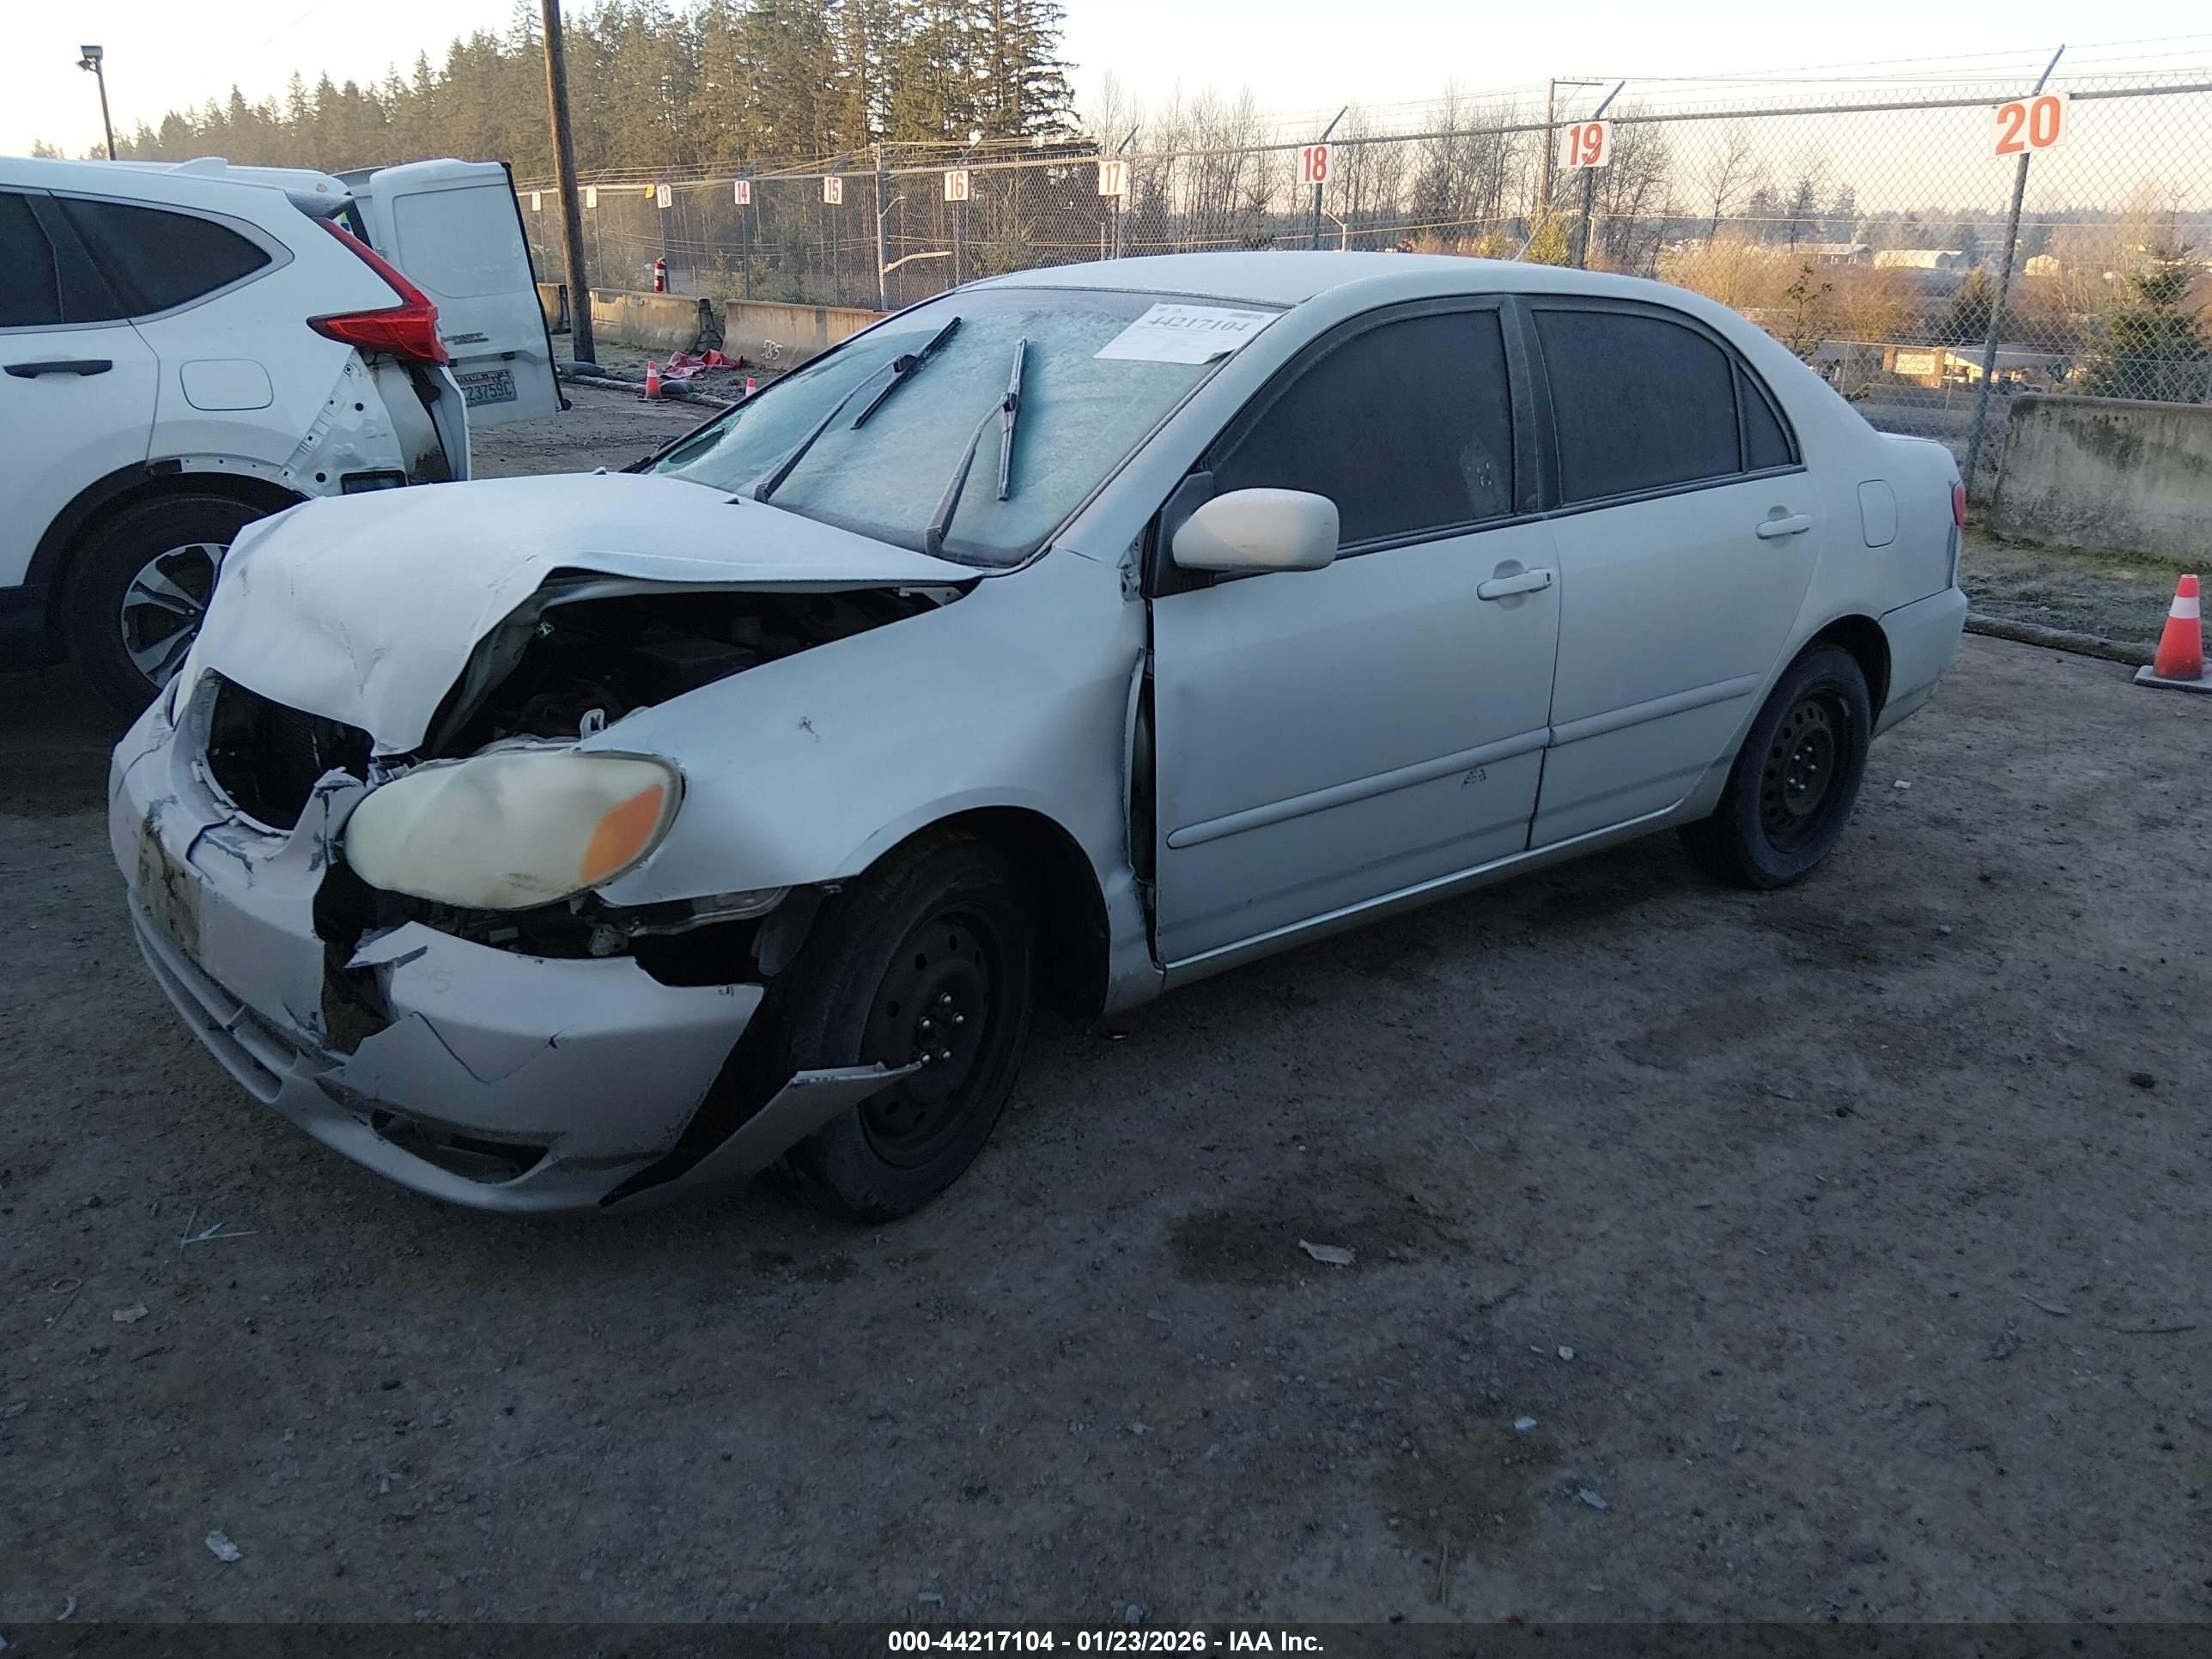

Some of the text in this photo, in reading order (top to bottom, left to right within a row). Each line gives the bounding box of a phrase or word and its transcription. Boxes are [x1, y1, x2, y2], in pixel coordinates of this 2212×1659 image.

[1994, 95, 2061, 155] 20
[1569, 123, 1604, 166] 19
[1304, 145, 1327, 182] 18
[827, 178, 839, 202] 15
[949, 172, 964, 199] 16
[1105, 163, 1121, 193] 17
[659, 186, 670, 206] 13
[738, 182, 747, 203] 14
[1148, 315, 1250, 331] 44217104
[761, 339, 782, 360] 585
